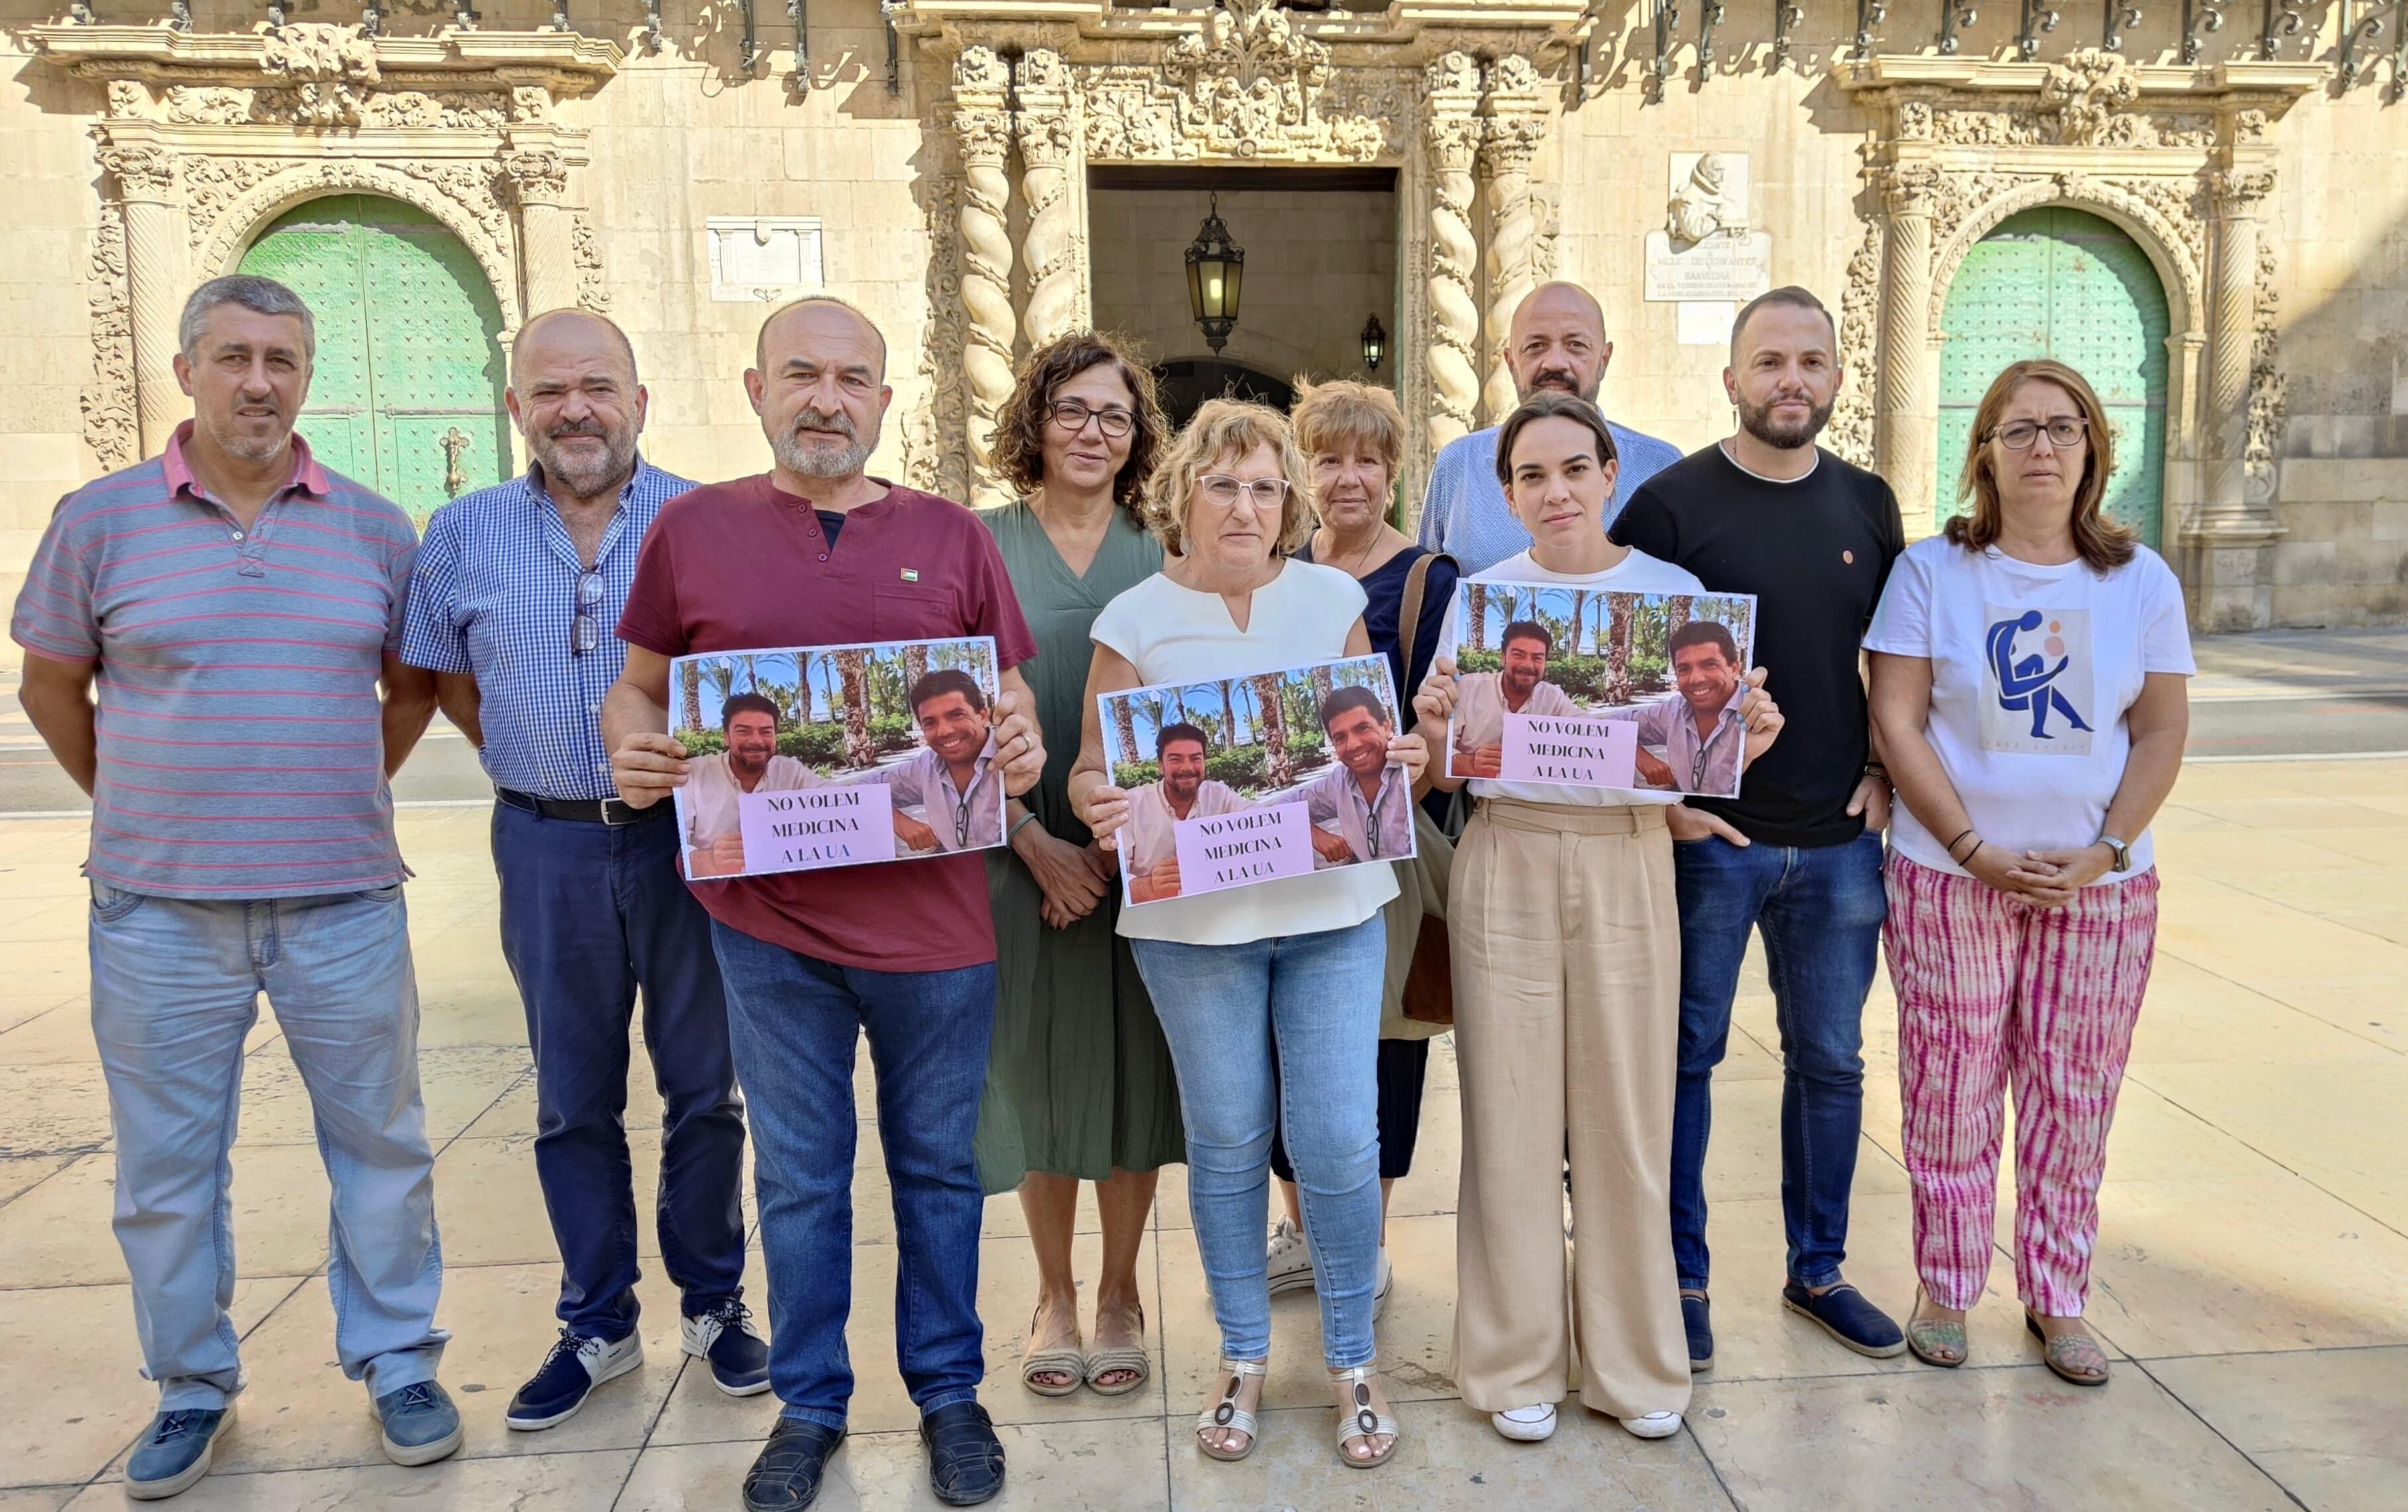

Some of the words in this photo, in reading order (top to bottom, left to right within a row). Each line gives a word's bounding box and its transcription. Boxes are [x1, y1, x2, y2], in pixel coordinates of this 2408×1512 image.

[1528, 720, 1550, 733] NO
[1555, 722, 1609, 737] VOLEM
[1528, 743, 1605, 759] MEDICINA
[1533, 765, 1543, 777] A
[1548, 767, 1567, 779] LA
[1573, 768, 1593, 780] UA
[767, 797, 793, 812] NO
[798, 792, 859, 809] VOLEM
[772, 818, 860, 838] MEDICINA
[1199, 821, 1223, 837] NO
[1227, 812, 1281, 832] VOLEM
[782, 850, 793, 863] A
[799, 847, 821, 861] LA
[825, 844, 851, 858] UA
[1205, 836, 1282, 861] MEDICINA
[1214, 870, 1225, 884] A
[1229, 866, 1249, 880] LA
[1253, 862, 1274, 876] UA
